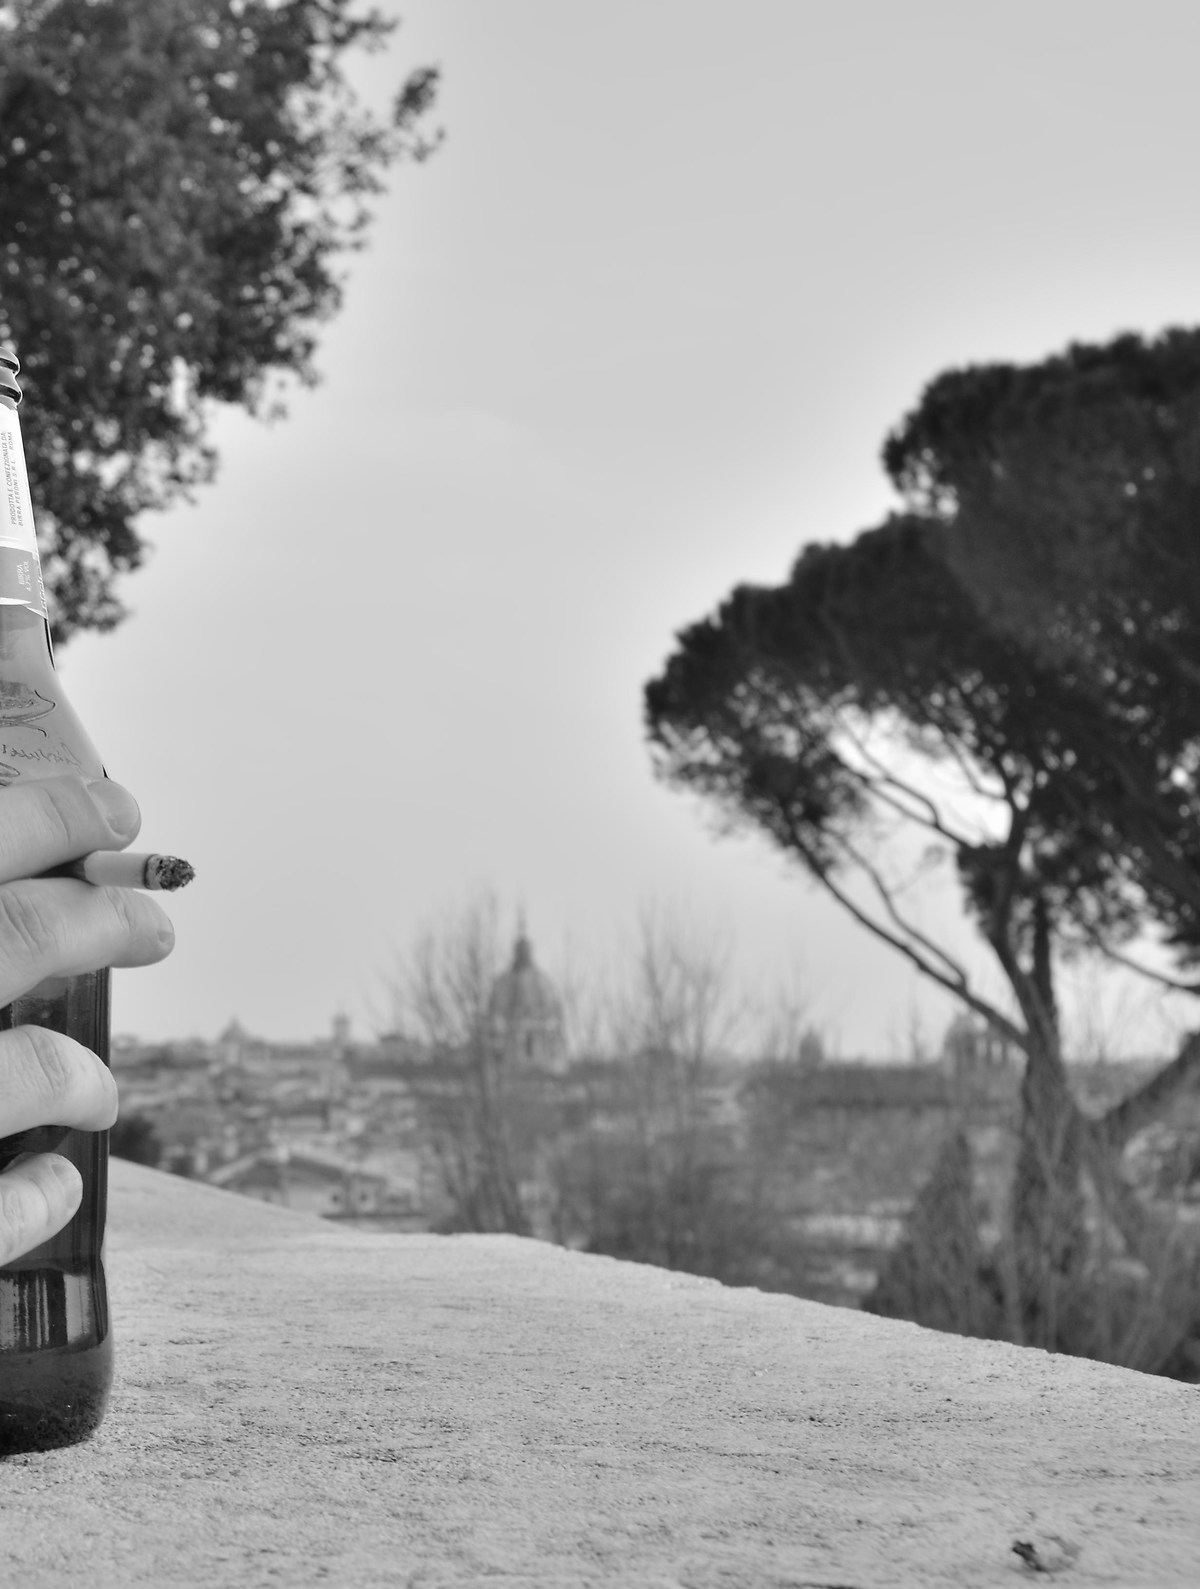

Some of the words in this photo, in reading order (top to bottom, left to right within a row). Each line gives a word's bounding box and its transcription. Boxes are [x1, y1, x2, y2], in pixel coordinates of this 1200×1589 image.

[2, 442, 13, 487] CONFEZIONATA
[13, 479, 21, 504] PERONI
[8, 494, 17, 525] PRODOTTA
